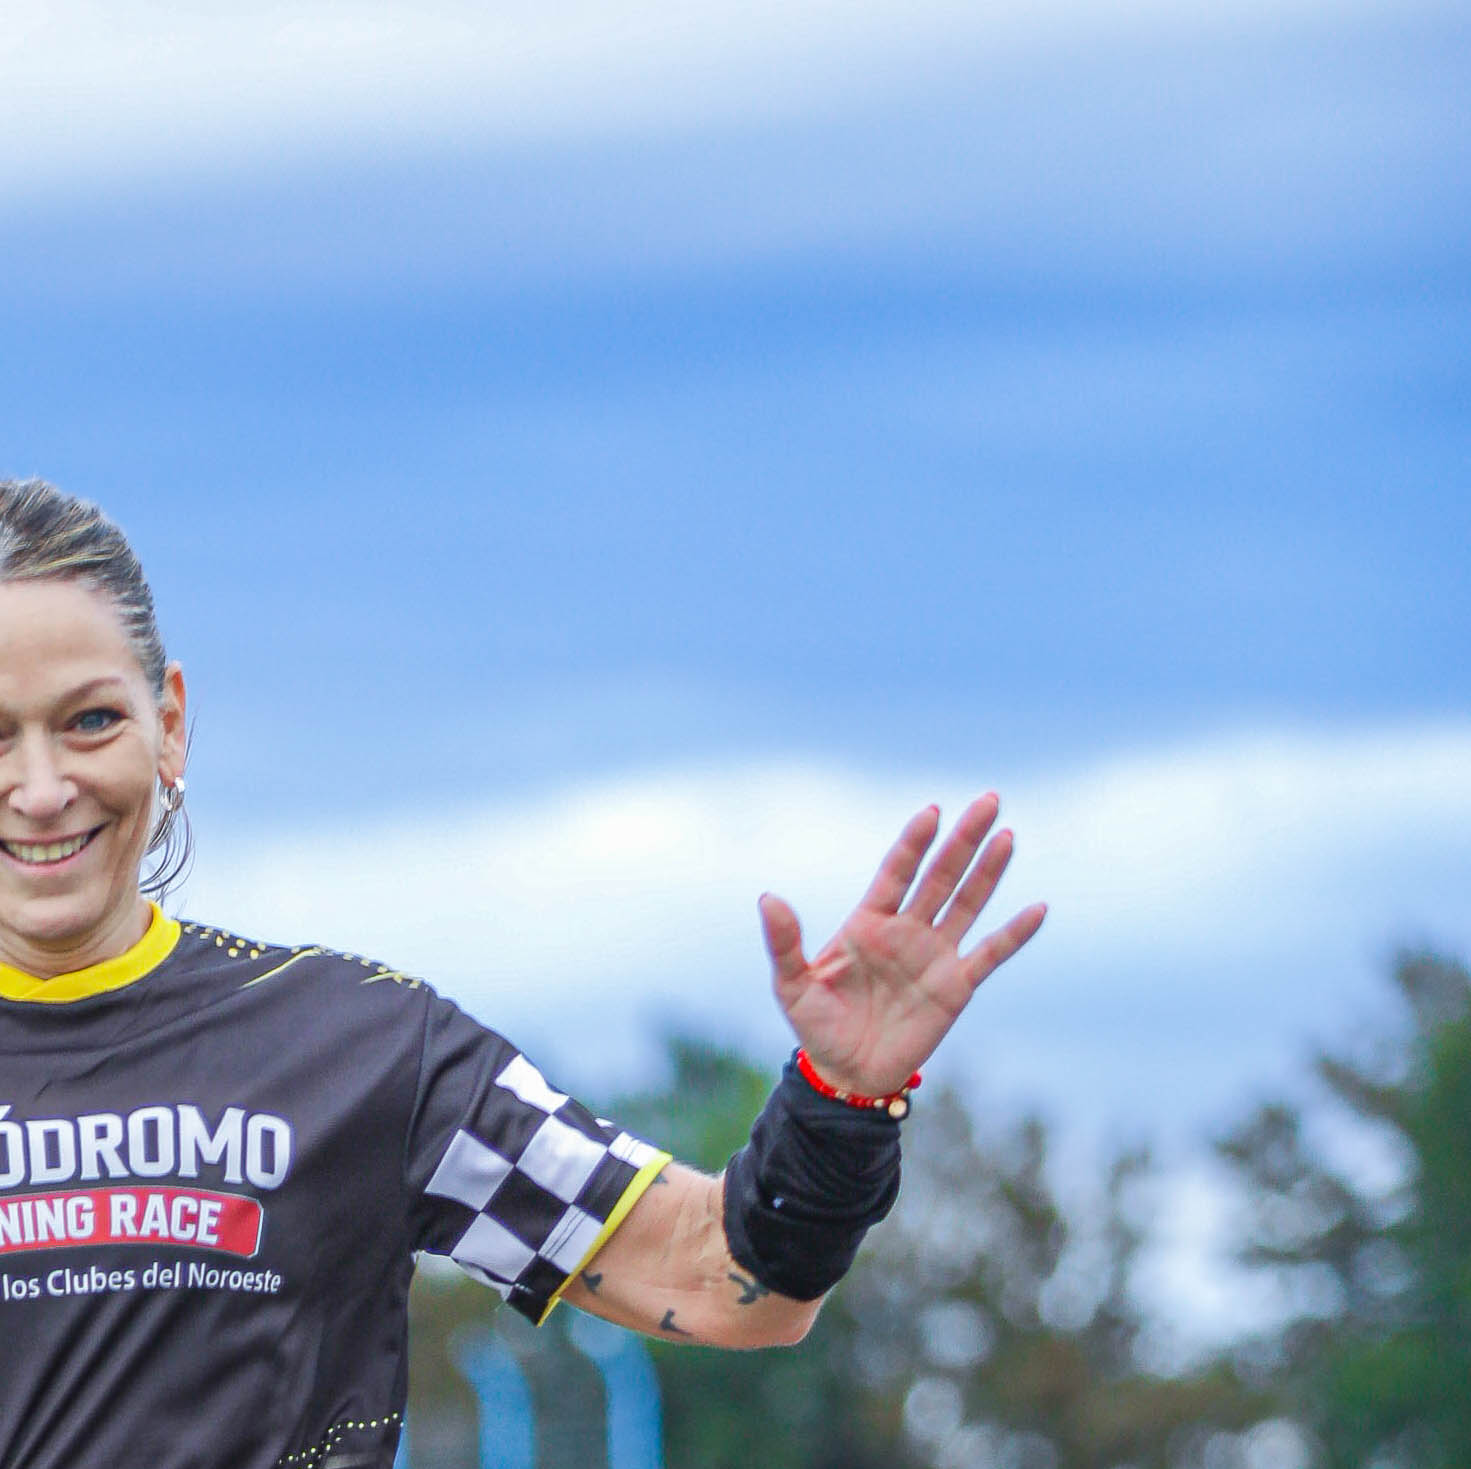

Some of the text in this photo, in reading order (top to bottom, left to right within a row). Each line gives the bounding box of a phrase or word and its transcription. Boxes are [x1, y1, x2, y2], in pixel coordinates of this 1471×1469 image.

[109, 1193, 223, 1246] RACE
[2, 1273, 41, 1300] los
[46, 1265, 136, 1297] Clubes
[141, 1261, 181, 1289] del
[186, 1261, 282, 1294] Noroeste
